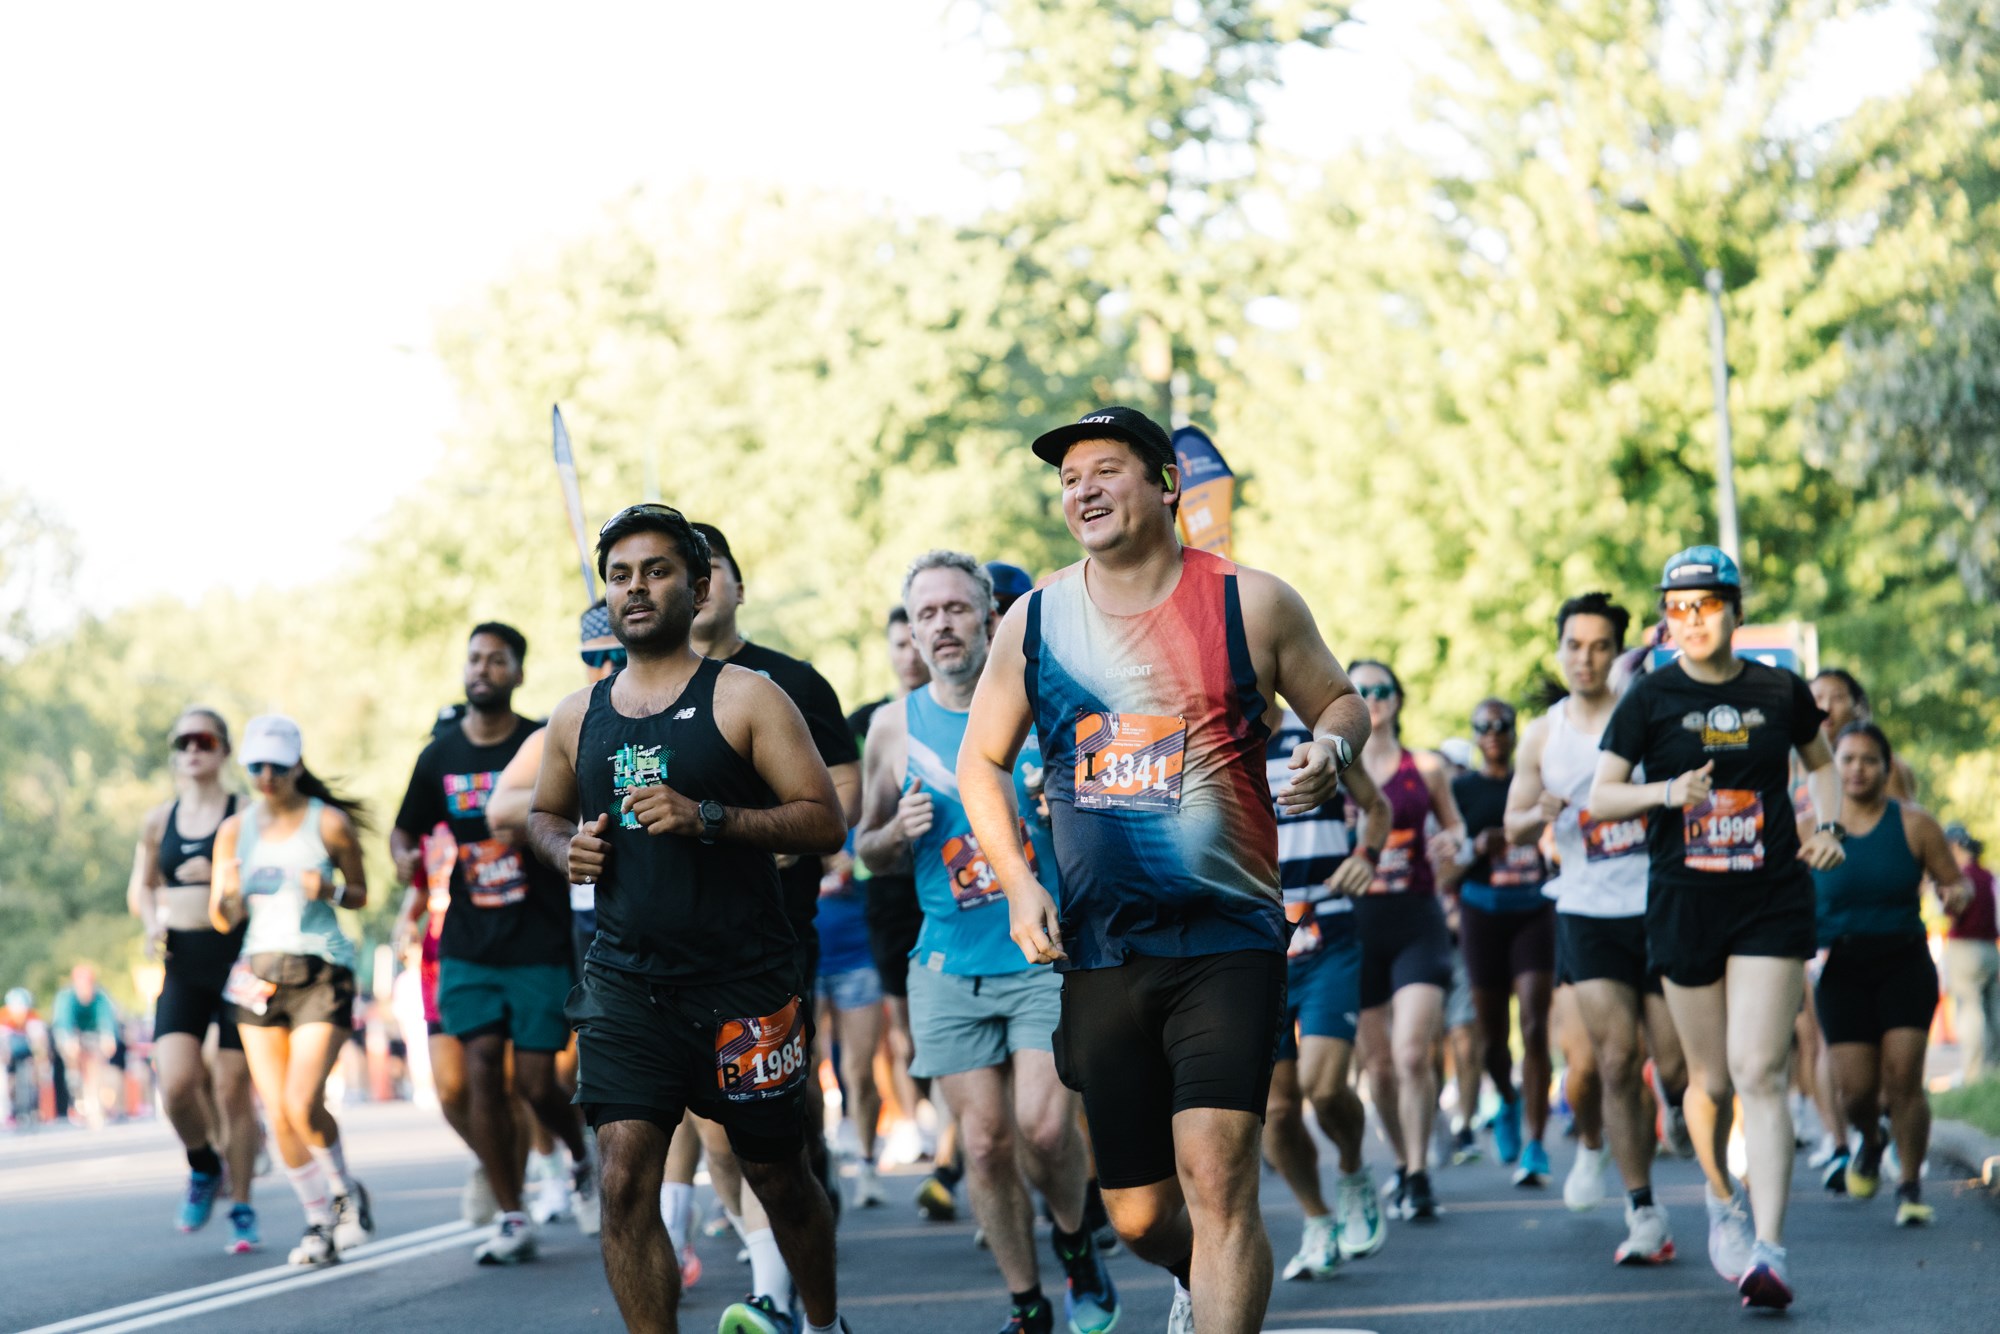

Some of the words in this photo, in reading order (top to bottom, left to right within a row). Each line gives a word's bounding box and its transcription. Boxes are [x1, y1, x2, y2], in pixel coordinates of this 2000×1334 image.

[1105, 664, 1152, 678] BANDIT
[1084, 752, 1096, 781] I
[1101, 752, 1168, 790] 3341
[956, 867, 973, 889] C
[723, 1064, 741, 1089] B
[752, 1035, 803, 1084] 1985
